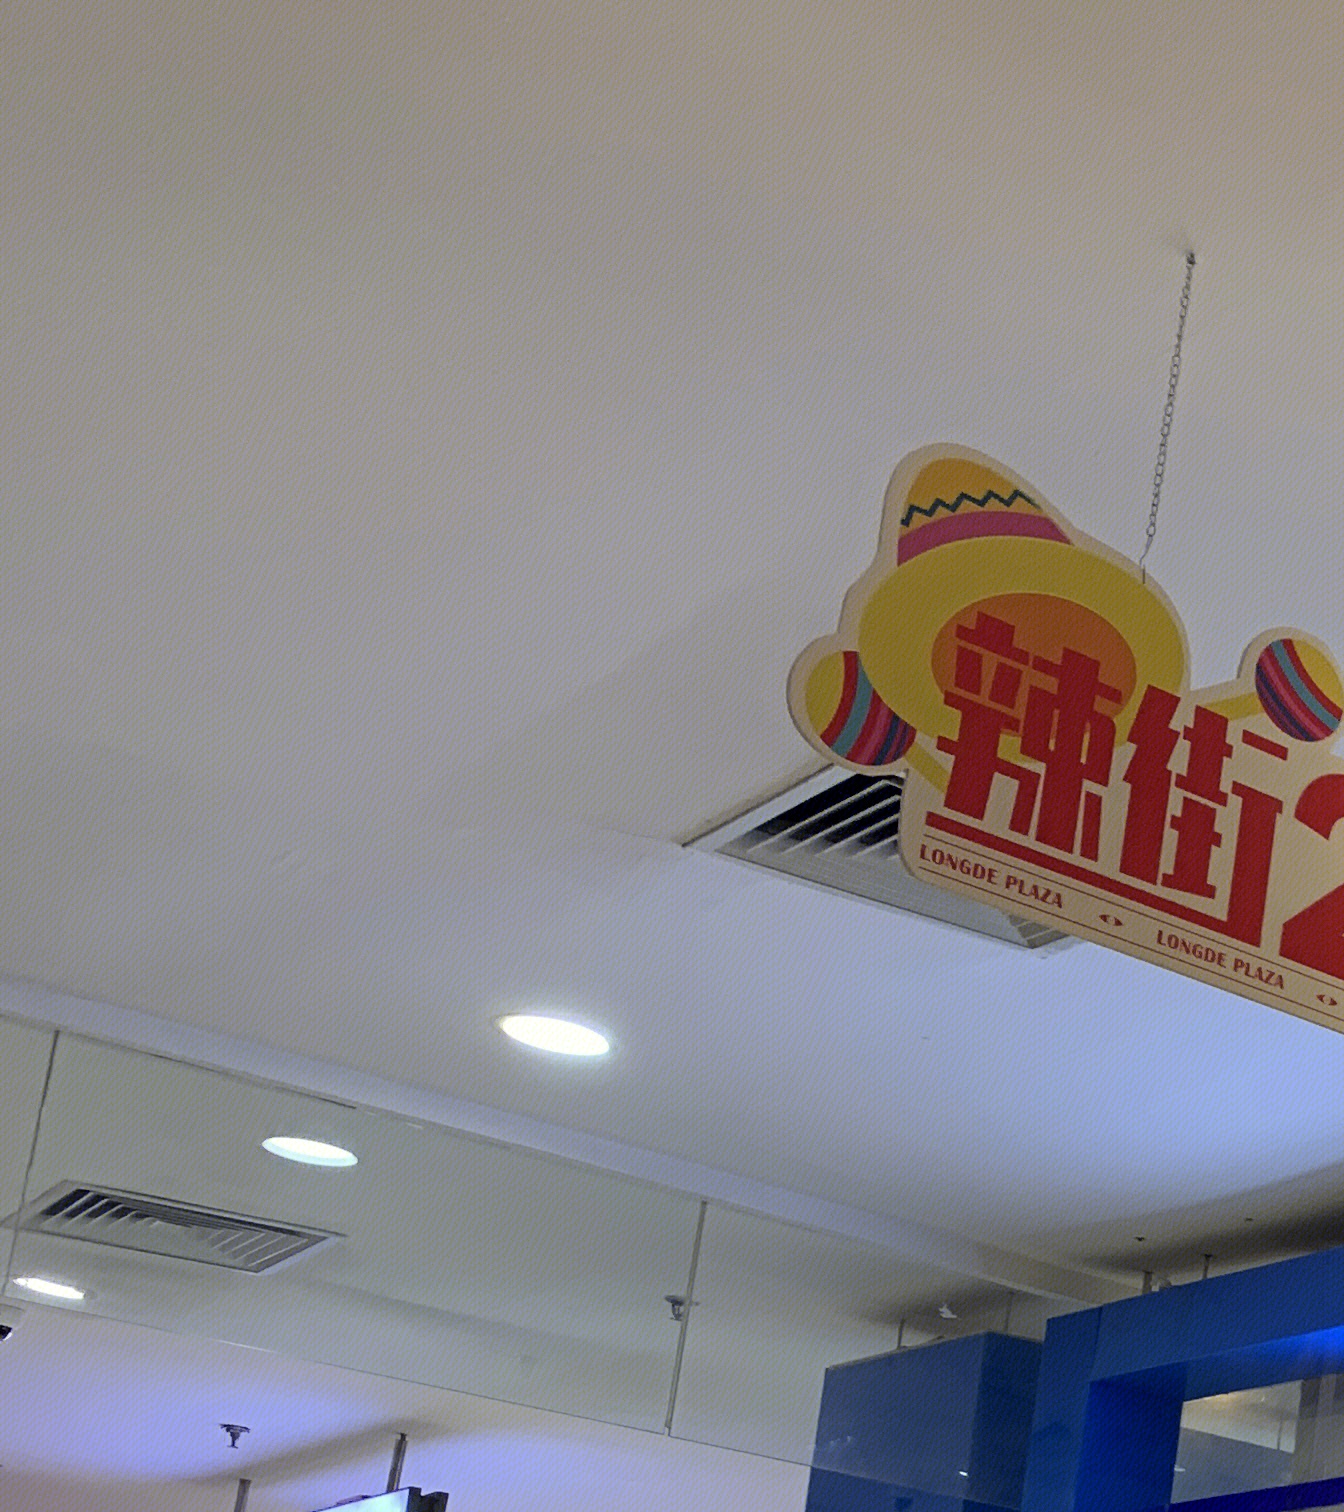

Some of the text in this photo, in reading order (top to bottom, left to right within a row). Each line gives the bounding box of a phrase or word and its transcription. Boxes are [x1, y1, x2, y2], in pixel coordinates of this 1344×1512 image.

[919, 842, 997, 889] LONGDE
[1004, 873, 1065, 910] PLAZA
[1156, 928, 1228, 970] LONGDE
[1232, 953, 1287, 992] PLAZA
